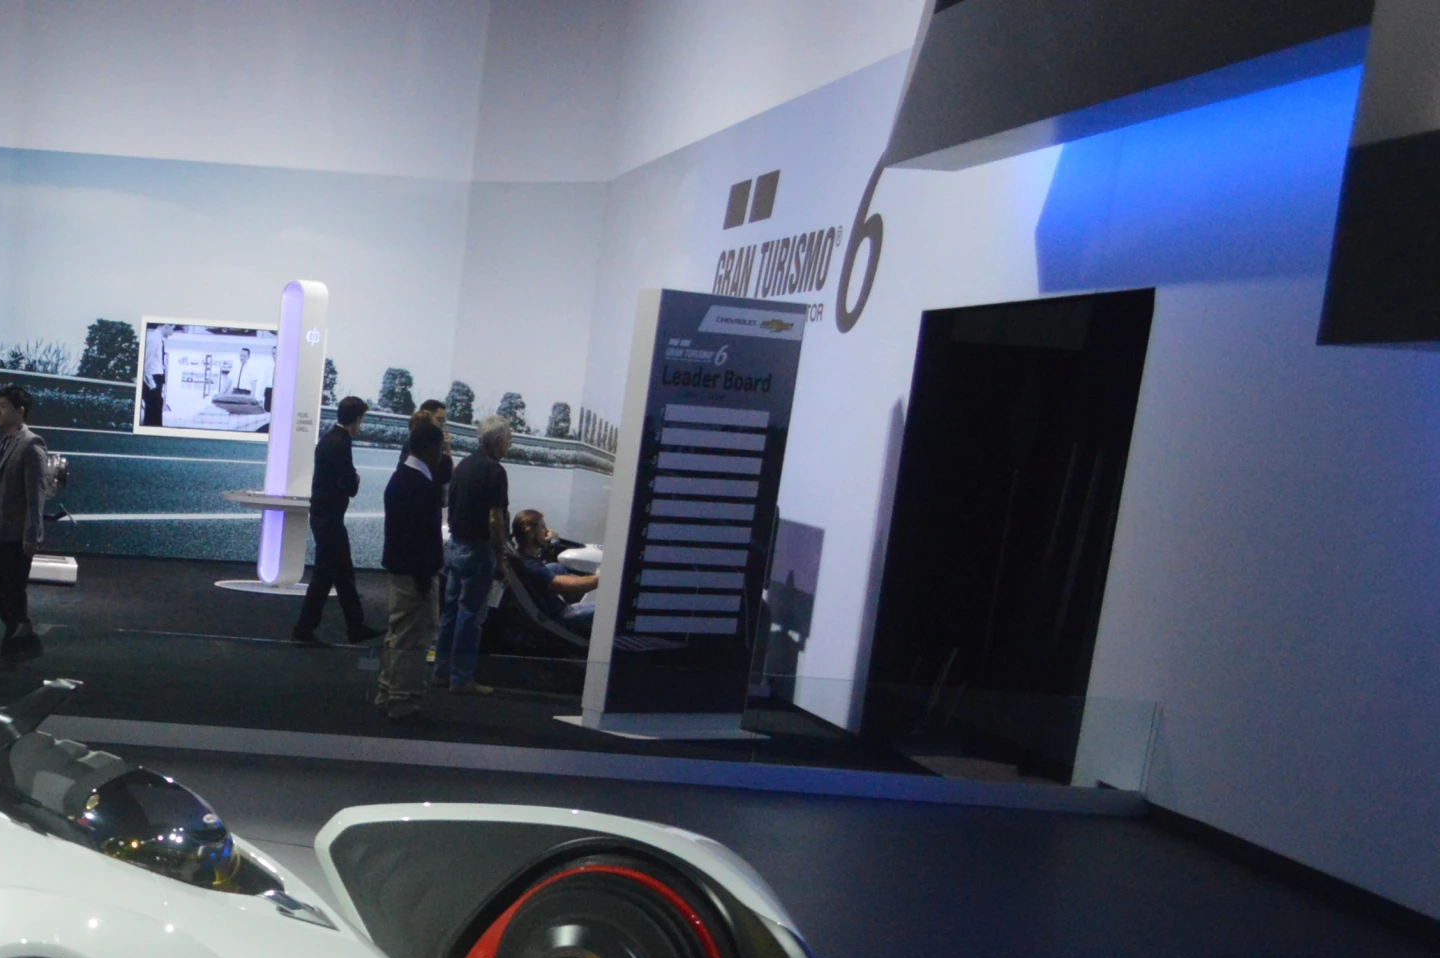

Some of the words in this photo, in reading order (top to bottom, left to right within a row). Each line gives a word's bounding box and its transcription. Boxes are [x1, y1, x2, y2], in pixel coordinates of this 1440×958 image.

[712, 244, 757, 297] GRAN
[835, 155, 885, 333] 6
[716, 316, 758, 326] CHEVROLET
[714, 344, 729, 366] 6
[662, 365, 721, 388] Leader
[723, 370, 772, 393] Board
